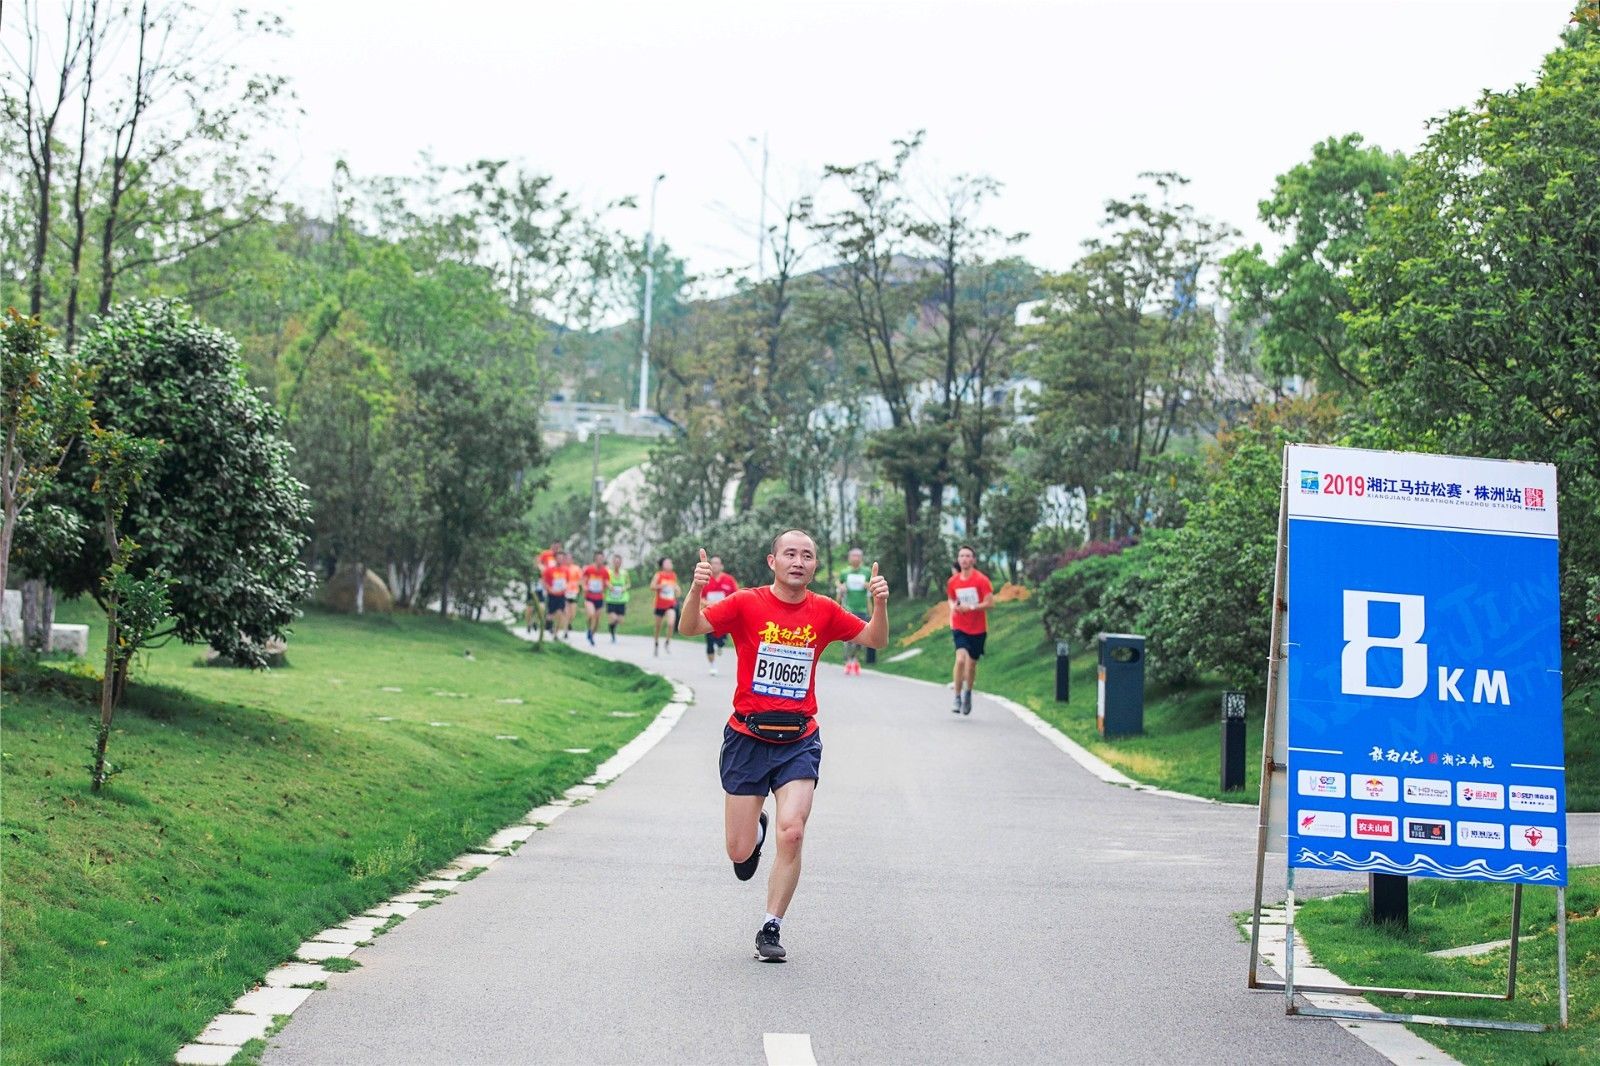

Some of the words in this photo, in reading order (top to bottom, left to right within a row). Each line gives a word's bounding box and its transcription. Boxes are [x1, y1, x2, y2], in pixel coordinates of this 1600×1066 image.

[1323, 474, 1365, 497] 2019
[1367, 477, 1522, 504] 湘江马拉松赛·株洲站
[1367, 494, 1412, 502] XIANGJIANG
[1414, 497, 1454, 505] MARATHON
[1455, 500, 1490, 508] ZHUZHOU
[1341, 589, 1428, 700] 8
[1438, 666, 1511, 706] KM
[758, 659, 805, 683] B10665
[1441, 752, 1495, 769] 湘江奔跑
